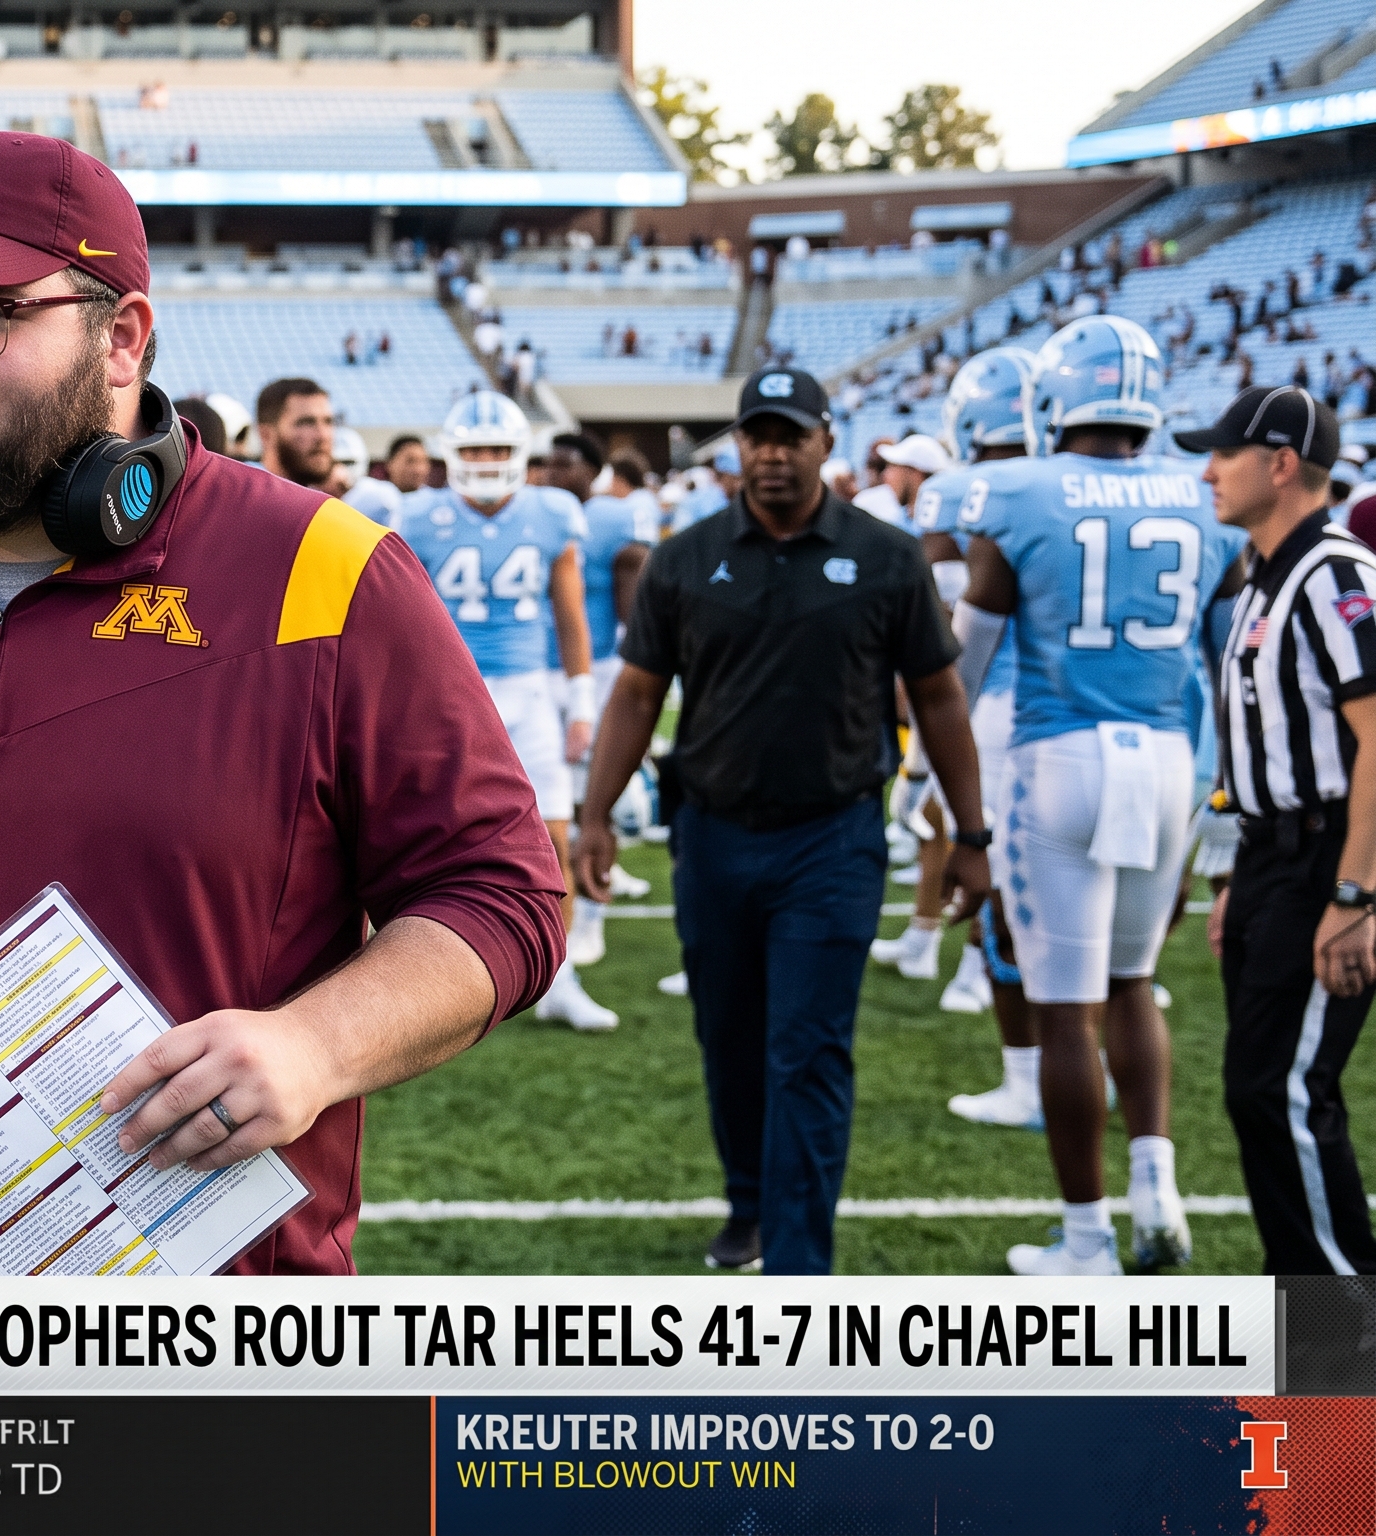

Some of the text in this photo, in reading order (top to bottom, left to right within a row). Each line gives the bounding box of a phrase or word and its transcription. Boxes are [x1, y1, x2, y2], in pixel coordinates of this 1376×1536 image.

[91, 583, 202, 647] M
[434, 544, 541, 622] 44
[1066, 516, 1202, 650] 13
